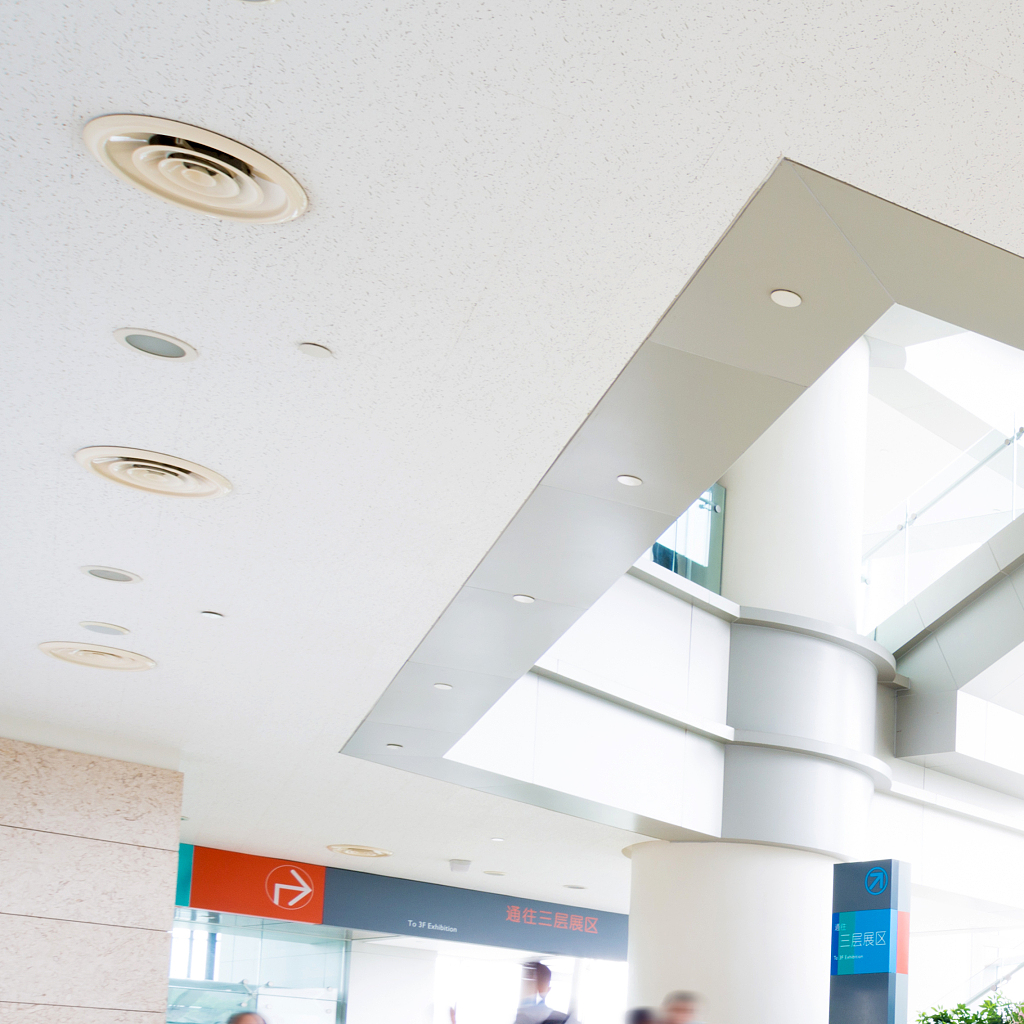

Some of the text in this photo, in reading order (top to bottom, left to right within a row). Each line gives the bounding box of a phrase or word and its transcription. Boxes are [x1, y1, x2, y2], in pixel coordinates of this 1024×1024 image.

[408, 919, 458, 932] To 3F Exhibition
[506, 905, 599, 934] 通往三层展区
[840, 931, 887, 947] 三层展区
